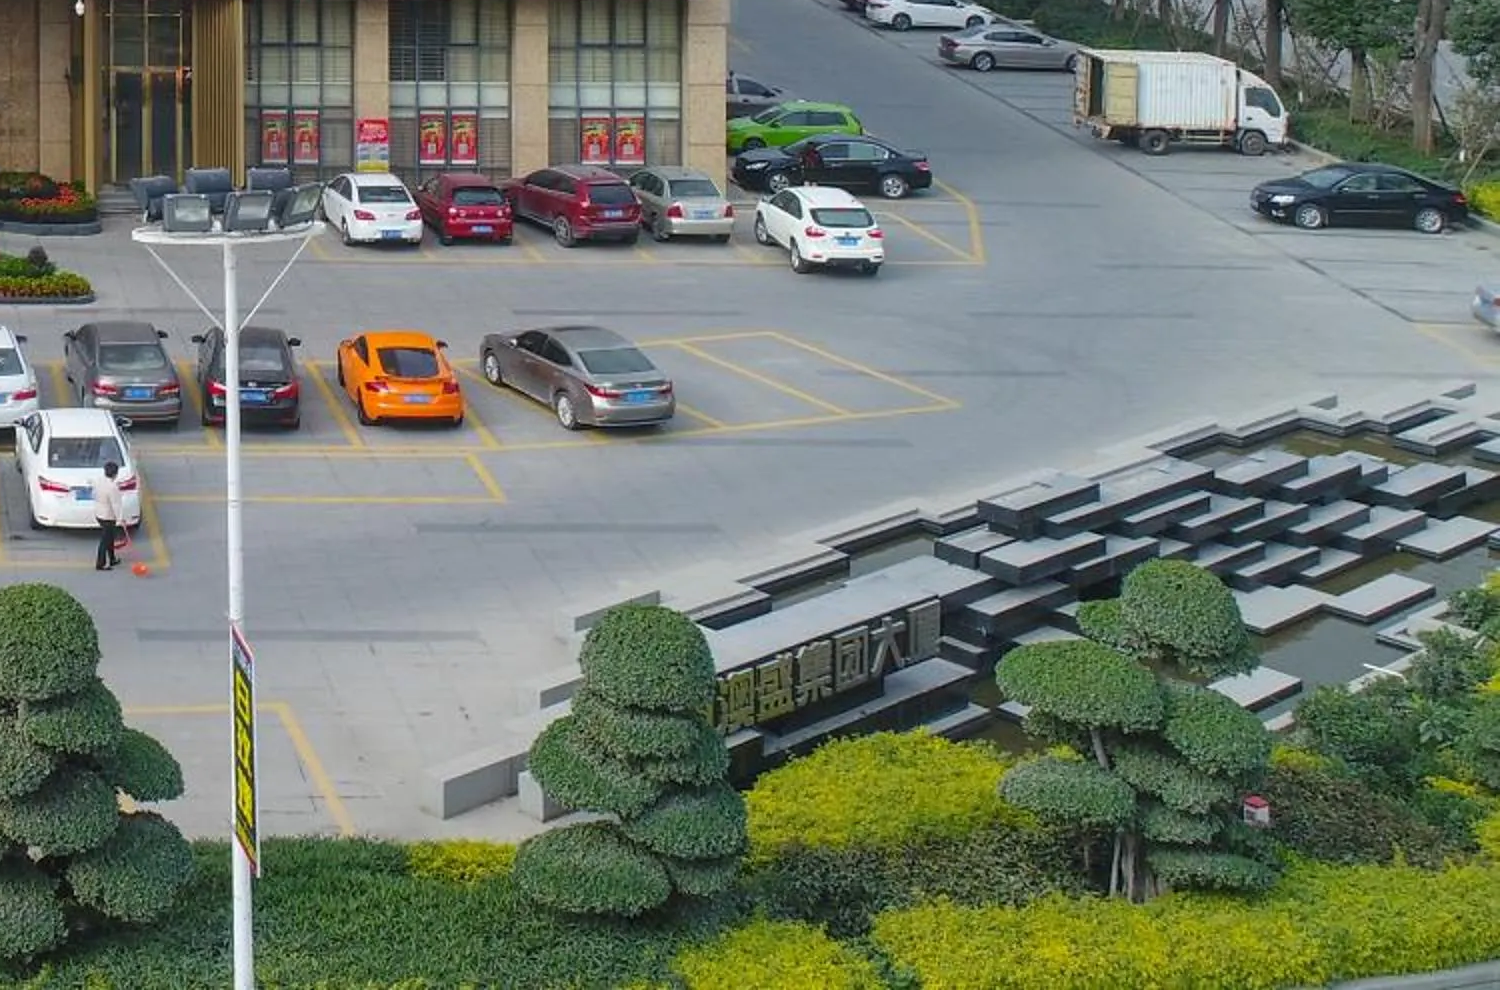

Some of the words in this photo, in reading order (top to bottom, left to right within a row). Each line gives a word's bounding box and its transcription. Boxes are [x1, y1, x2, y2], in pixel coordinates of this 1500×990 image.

[716, 599, 942, 734] 澳盛集团大厦
